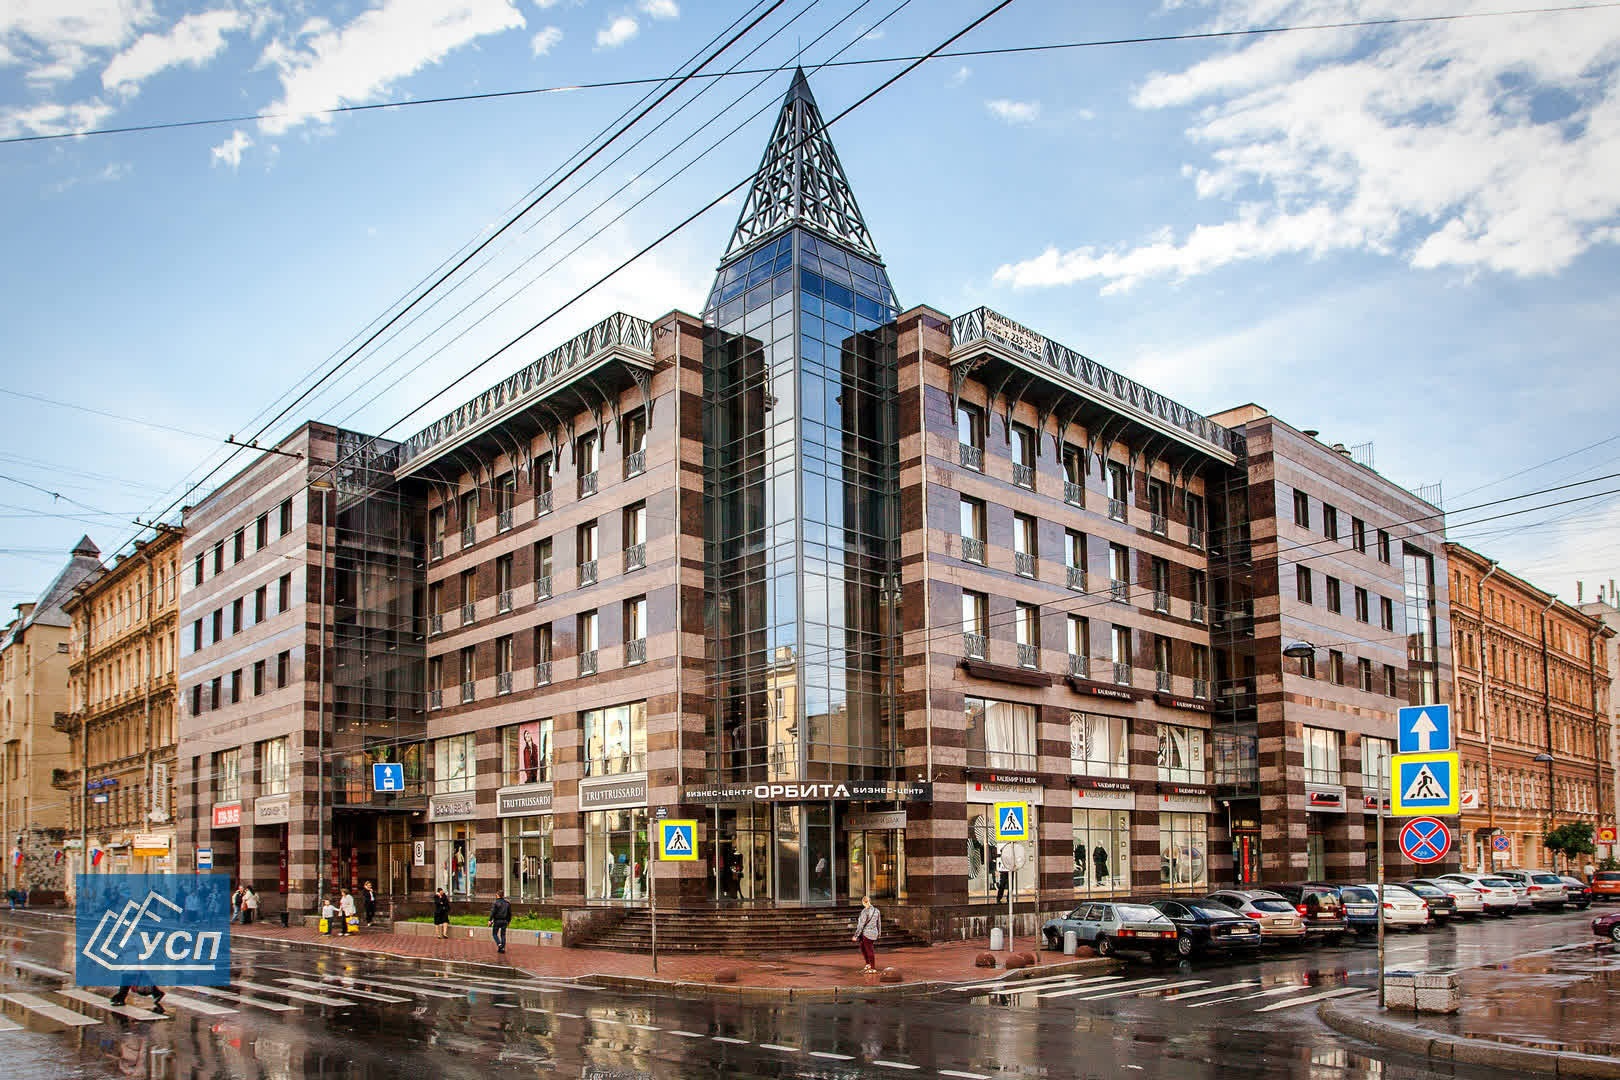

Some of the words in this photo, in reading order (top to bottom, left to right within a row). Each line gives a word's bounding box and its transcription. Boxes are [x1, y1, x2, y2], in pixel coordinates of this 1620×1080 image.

[1011, 332, 1042, 354] 235-35-33
[686, 788, 753, 798] БИЗНЕС-ЦЕНТР
[754, 784, 851, 799] ОРБИТА
[853, 787, 924, 795] БИЗНЕС-ЦЕНТР
